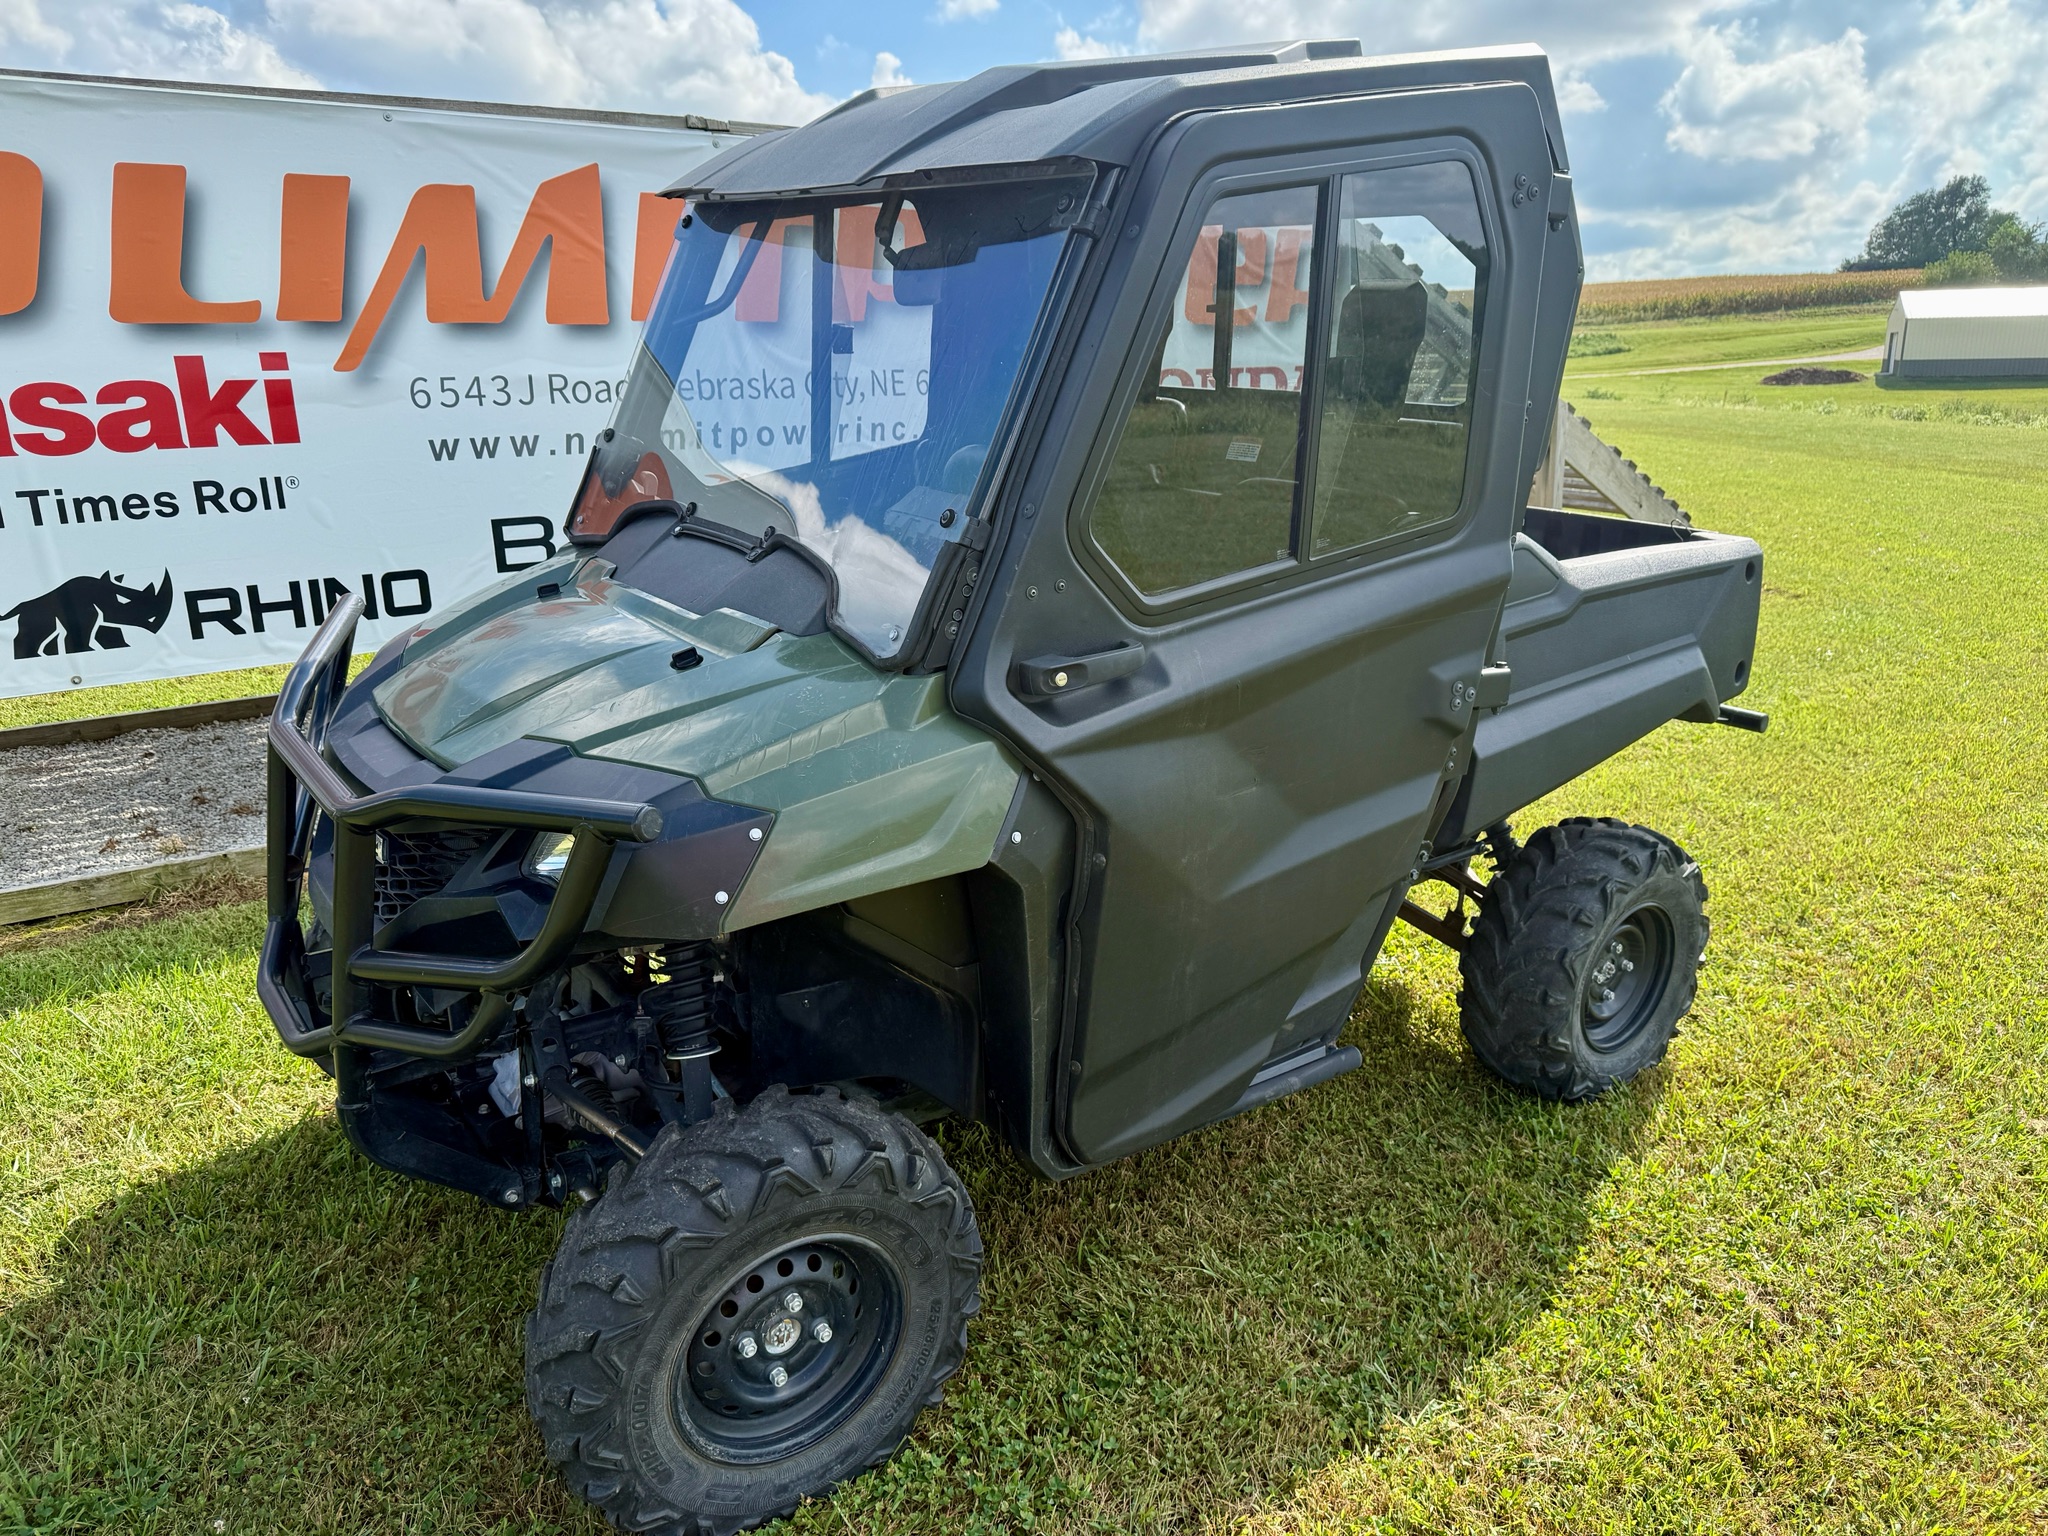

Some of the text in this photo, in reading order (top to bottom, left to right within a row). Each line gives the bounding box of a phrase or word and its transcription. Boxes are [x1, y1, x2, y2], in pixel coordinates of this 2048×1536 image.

[0, 352, 300, 458] saki
[677, 369, 796, 401] ebraska
[871, 369, 905, 397] NE
[15, 488, 180, 527] Times
[183, 569, 432, 640] RHINO
